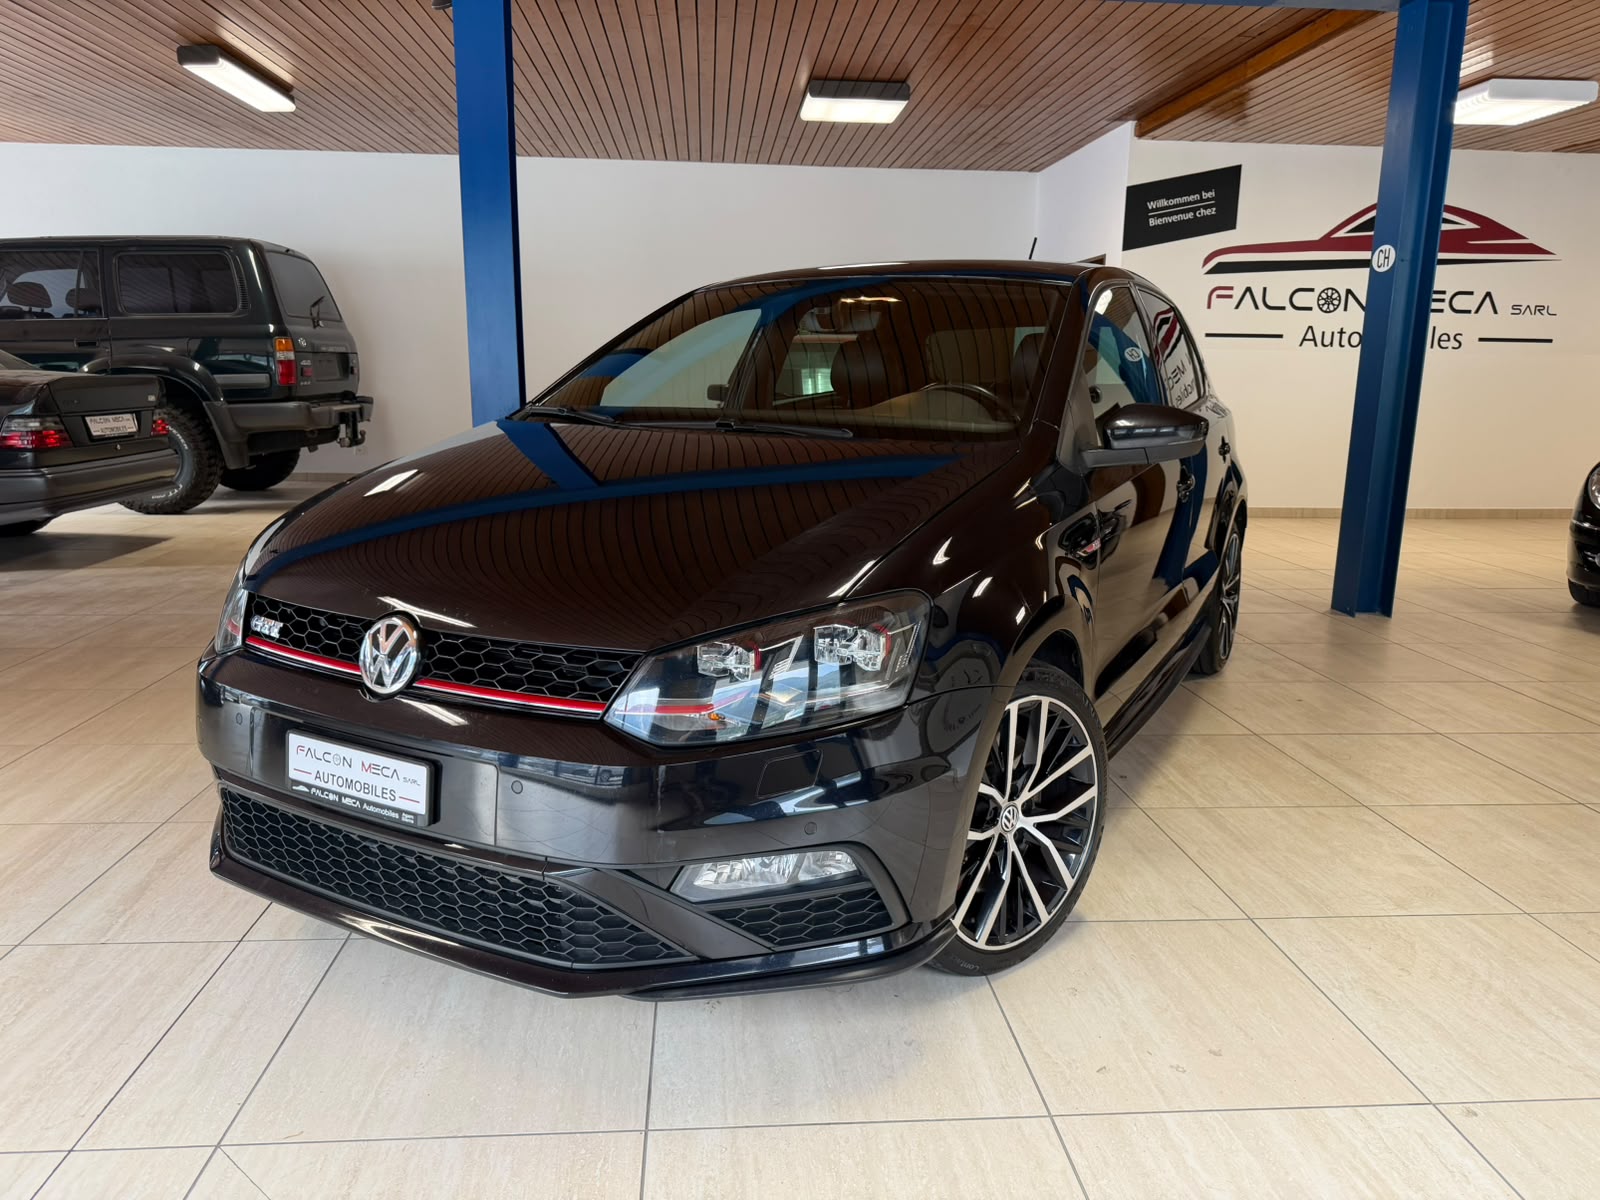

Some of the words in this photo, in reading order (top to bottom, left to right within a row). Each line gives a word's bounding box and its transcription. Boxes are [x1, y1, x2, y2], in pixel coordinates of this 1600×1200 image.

[1147, 193, 1200, 210] Willkommen
[1201, 188, 1216, 200] bei
[1148, 212, 1195, 227] Bienvenue
[1196, 207, 1217, 218] chez
[1376, 247, 1392, 269] CH
[1430, 290, 1498, 315] ECA
[1510, 304, 1558, 316] SARL
[1299, 325, 1463, 350] Autoles
[296, 745, 352, 769] FALCON
[361, 760, 400, 781] MECA
[314, 770, 396, 802] AUTOMOBILES
[310, 787, 339, 803] FALCON
[341, 795, 361, 809] MECA
[362, 802, 399, 820] Automobiles
